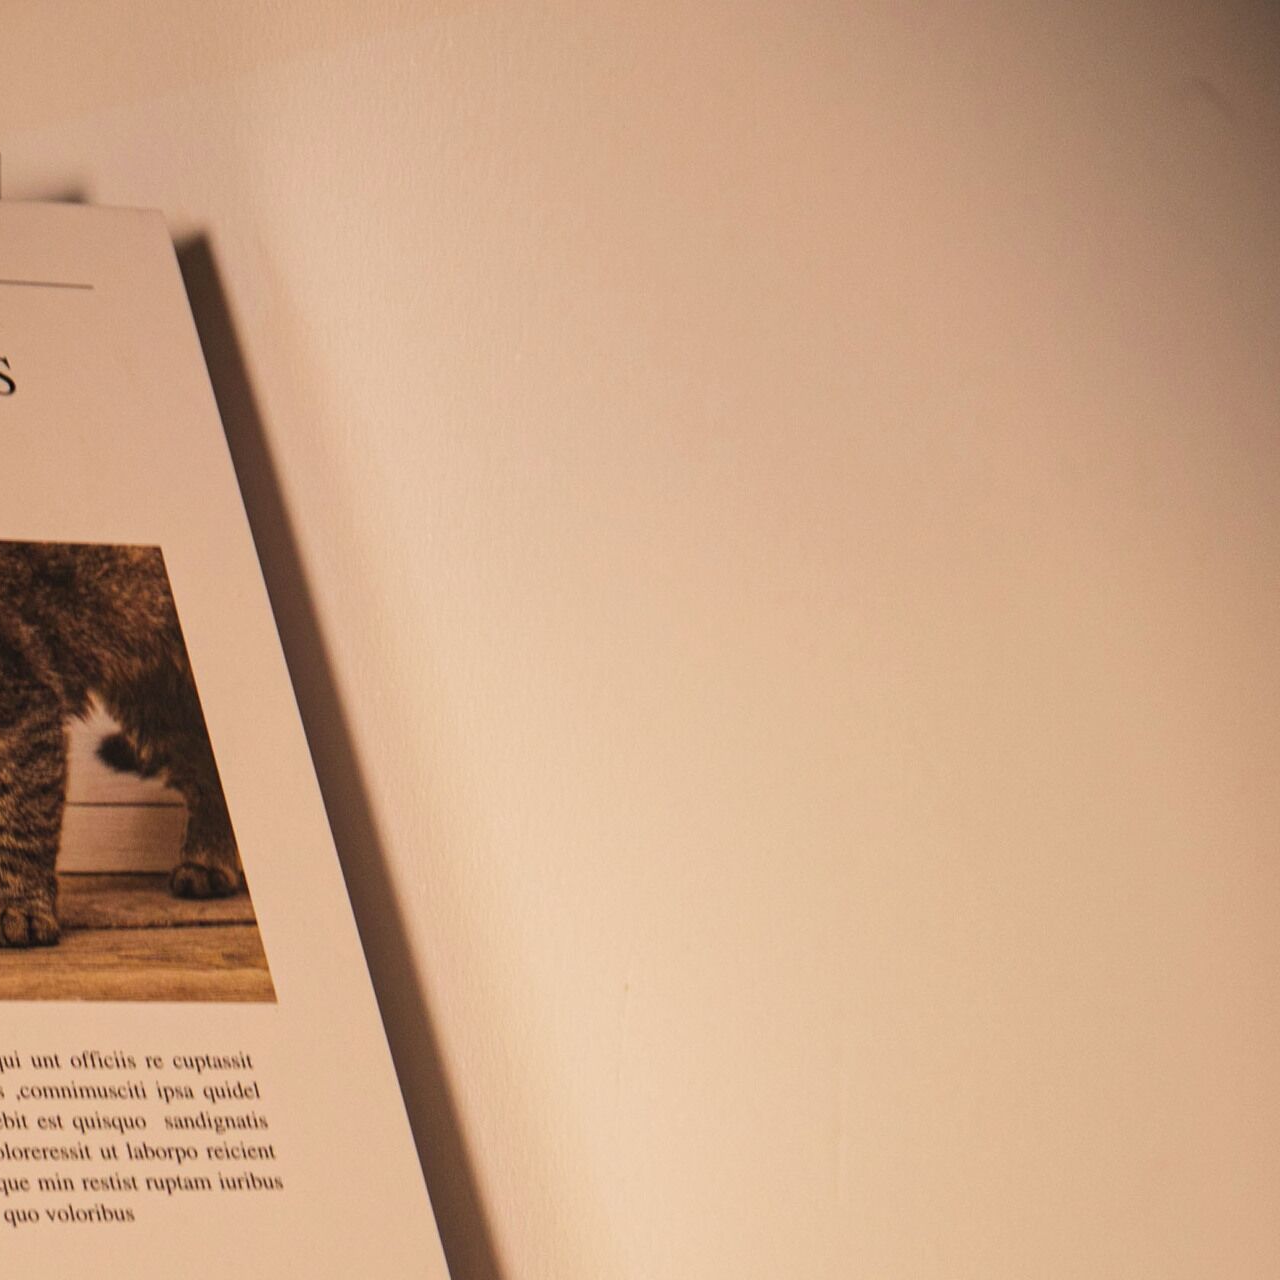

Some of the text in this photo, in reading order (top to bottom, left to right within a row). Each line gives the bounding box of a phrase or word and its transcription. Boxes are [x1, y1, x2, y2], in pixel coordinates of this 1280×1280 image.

[30, 1051, 61, 1069] unt
[70, 1049, 137, 1069] officiis
[145, 1054, 163, 1069] re
[172, 1049, 253, 1074] cuptassit
[157, 1081, 195, 1105] ipsa
[202, 1079, 261, 1104] quidel
[36, 1112, 64, 1130] est
[72, 1111, 147, 1135] quisquo
[164, 1109, 269, 1134] sandignatis
[100, 1143, 118, 1161] ut
[126, 1139, 199, 1165] laborpo
[206, 1139, 276, 1160] reicient
[38, 1173, 75, 1192] min
[82, 1173, 138, 1191] restist
[145, 1173, 212, 1196] ruptam
[219, 1170, 284, 1191] iuribus
[3, 1207, 40, 1228] quo
[45, 1201, 135, 1223] voloribus
